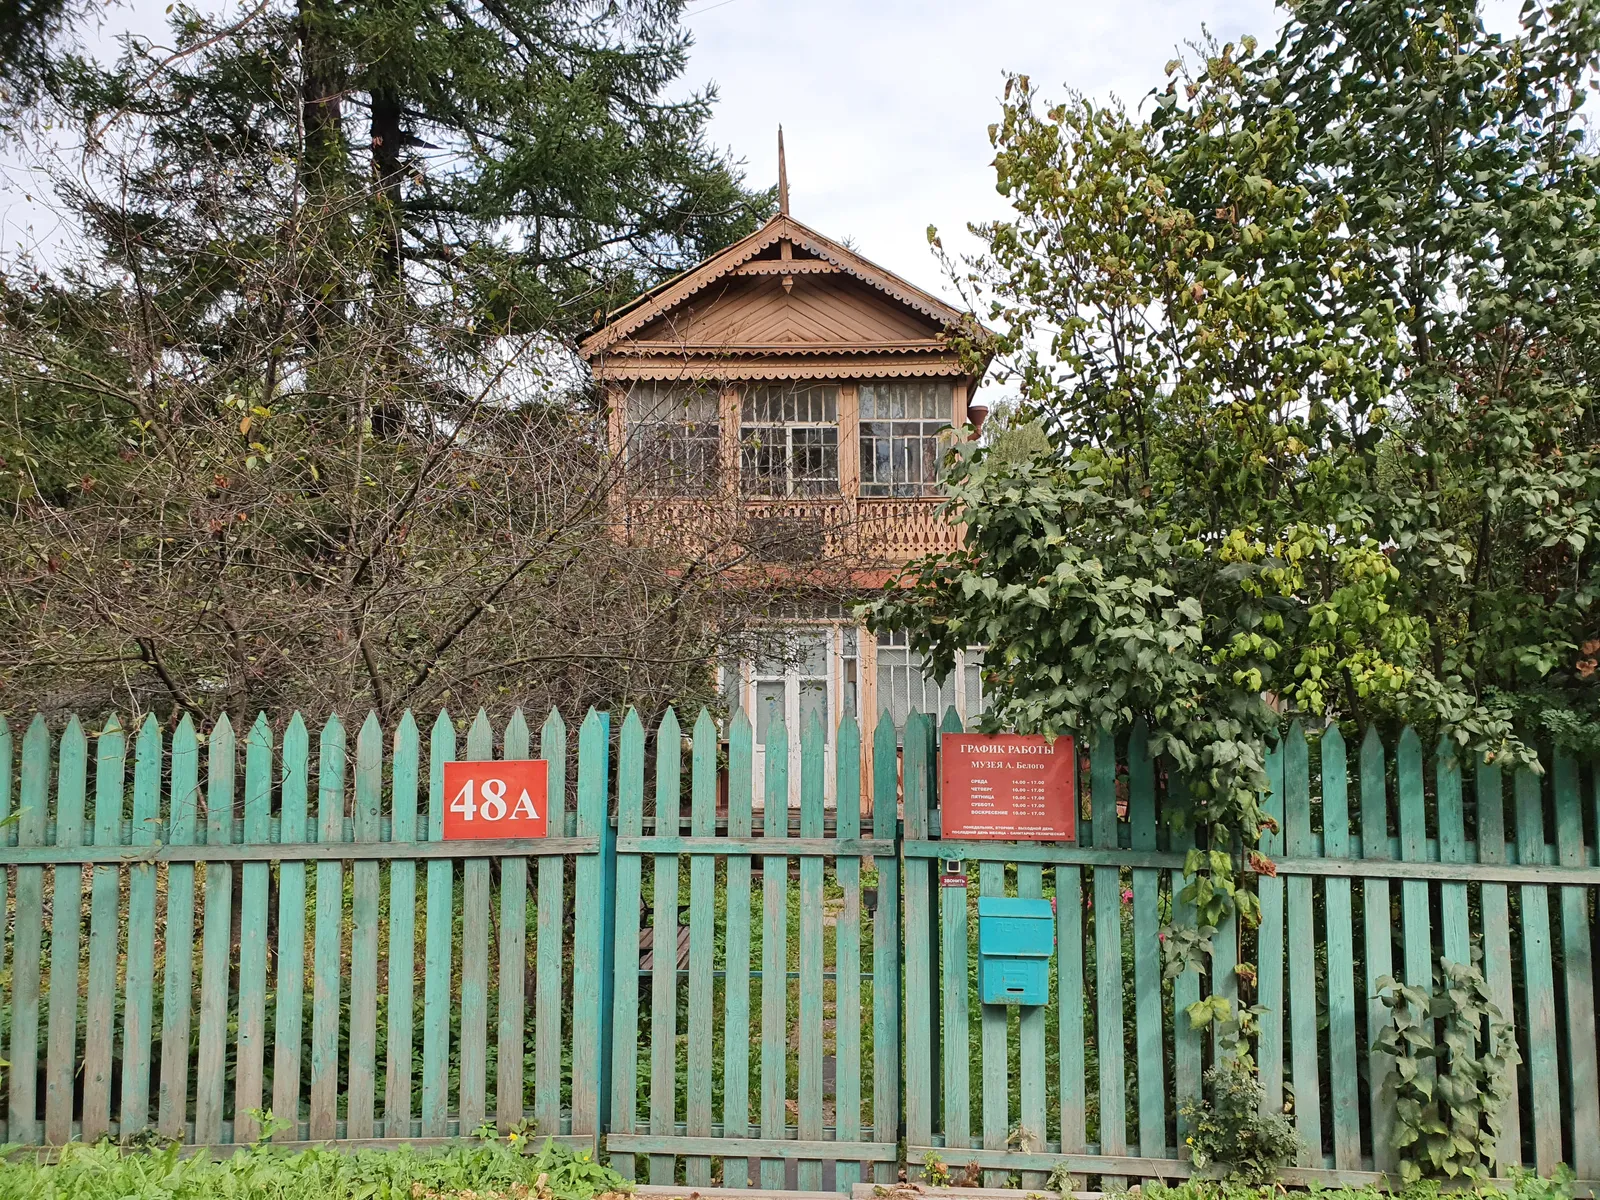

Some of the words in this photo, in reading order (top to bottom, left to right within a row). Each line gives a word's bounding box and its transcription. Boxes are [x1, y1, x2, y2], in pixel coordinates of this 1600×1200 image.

[961, 744, 1005, 753] ГРАФИК
[1008, 745, 1054, 754] РАБОТЫ
[971, 761, 1003, 769] МУЗЕЯ
[1016, 761, 1045, 769] Белого
[450, 779, 540, 821] 48А
